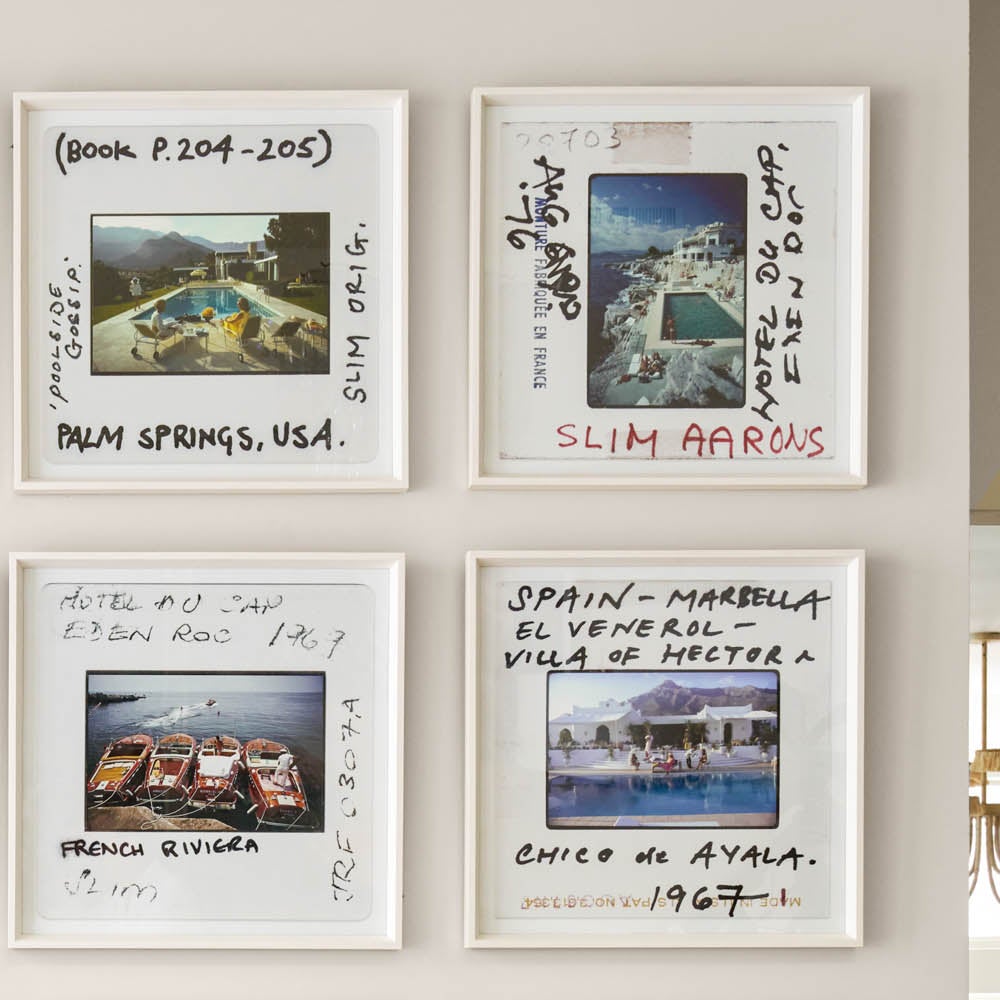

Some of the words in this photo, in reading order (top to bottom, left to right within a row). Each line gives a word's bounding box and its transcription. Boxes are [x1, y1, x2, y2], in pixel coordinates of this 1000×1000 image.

[533, 326, 547, 340] EN
[342, 335, 370, 403] SLIM
[533, 347, 547, 390] FRANCE
[57, 423, 124, 453] PALM
[138, 423, 264, 455] SPRINGS,
[557, 422, 658, 457] SLIM
[682, 422, 825, 459] AARONS
[507, 582, 636, 613] SPAIN
[666, 585, 831, 620] MARBELLA
[516, 620, 551, 641] EL
[504, 646, 589, 670] VILLA
[609, 648, 641, 665] OF
[662, 644, 782, 665] HECTOR
[59, 840, 144, 858] FRENCH
[161, 838, 259, 857] RIVIERA
[515, 843, 614, 866] CHICO
